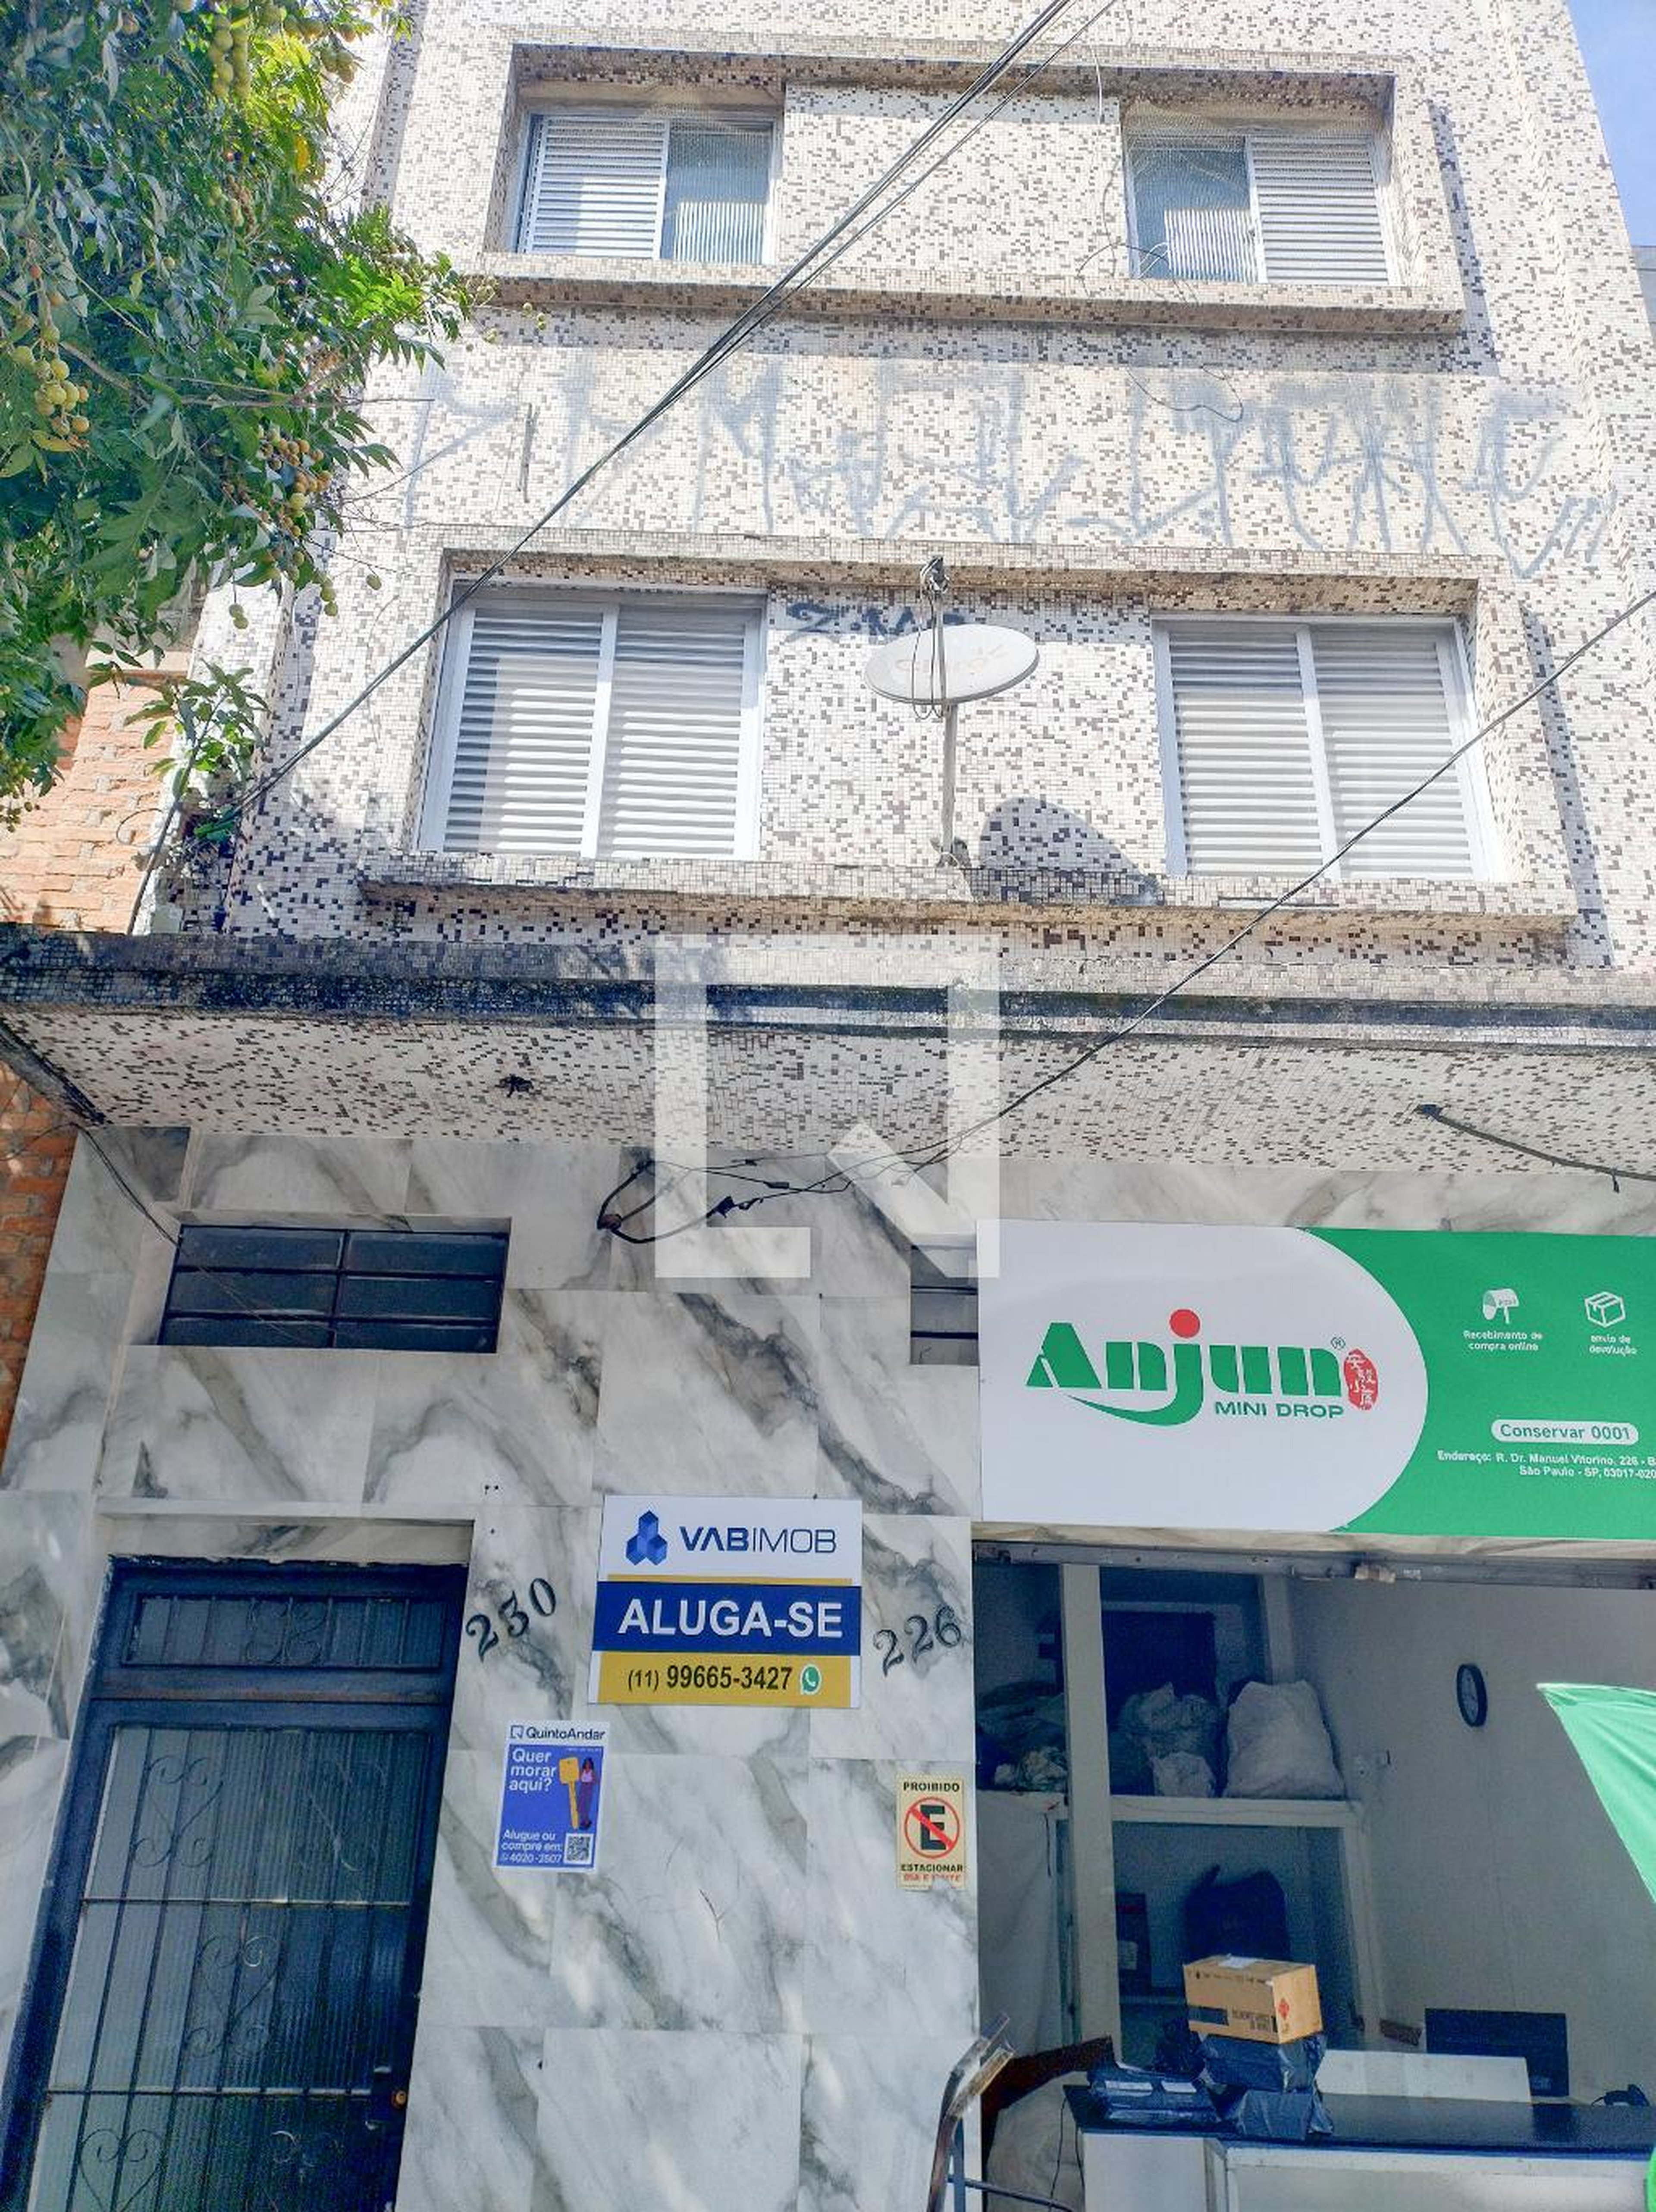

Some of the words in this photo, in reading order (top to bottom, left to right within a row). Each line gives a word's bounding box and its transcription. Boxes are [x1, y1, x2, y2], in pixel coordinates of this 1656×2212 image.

[1468, 1343, 1506, 1352] compra
[1026, 1309, 1342, 1427] Anjun
[1215, 1401, 1267, 1417] MINI
[1276, 1403, 1344, 1419] DROP
[1500, 1424, 1585, 1439] Conservar
[1591, 1426, 1630, 1440] 0001
[1496, 1453, 1508, 1463] R.
[1510, 1453, 1526, 1463] Dr.
[1529, 1454, 1568, 1464] Manuel
[1519, 1465, 1540, 1476] São
[1544, 1466, 1574, 1476] Paulo
[679, 1526, 836, 1554] VABIMOB
[466, 1578, 555, 1663] 230
[618, 1598, 843, 1638] ALUGA-SE
[873, 1605, 961, 1677] 226
[627, 1669, 660, 1691] (11)
[667, 1664, 793, 1690] 99665-3427
[526, 1726, 605, 1740] QuintoAndar
[512, 1748, 552, 1762] Quer
[510, 1765, 556, 1777] morar
[509, 1777, 552, 1793] aqui?
[903, 1782, 960, 1792] PROIBIDO
[502, 1829, 540, 1842] Alugue
[542, 1832, 555, 1841] ou
[501, 1842, 542, 1852] compre
[901, 1864, 963, 1872] ESTACIONAR
